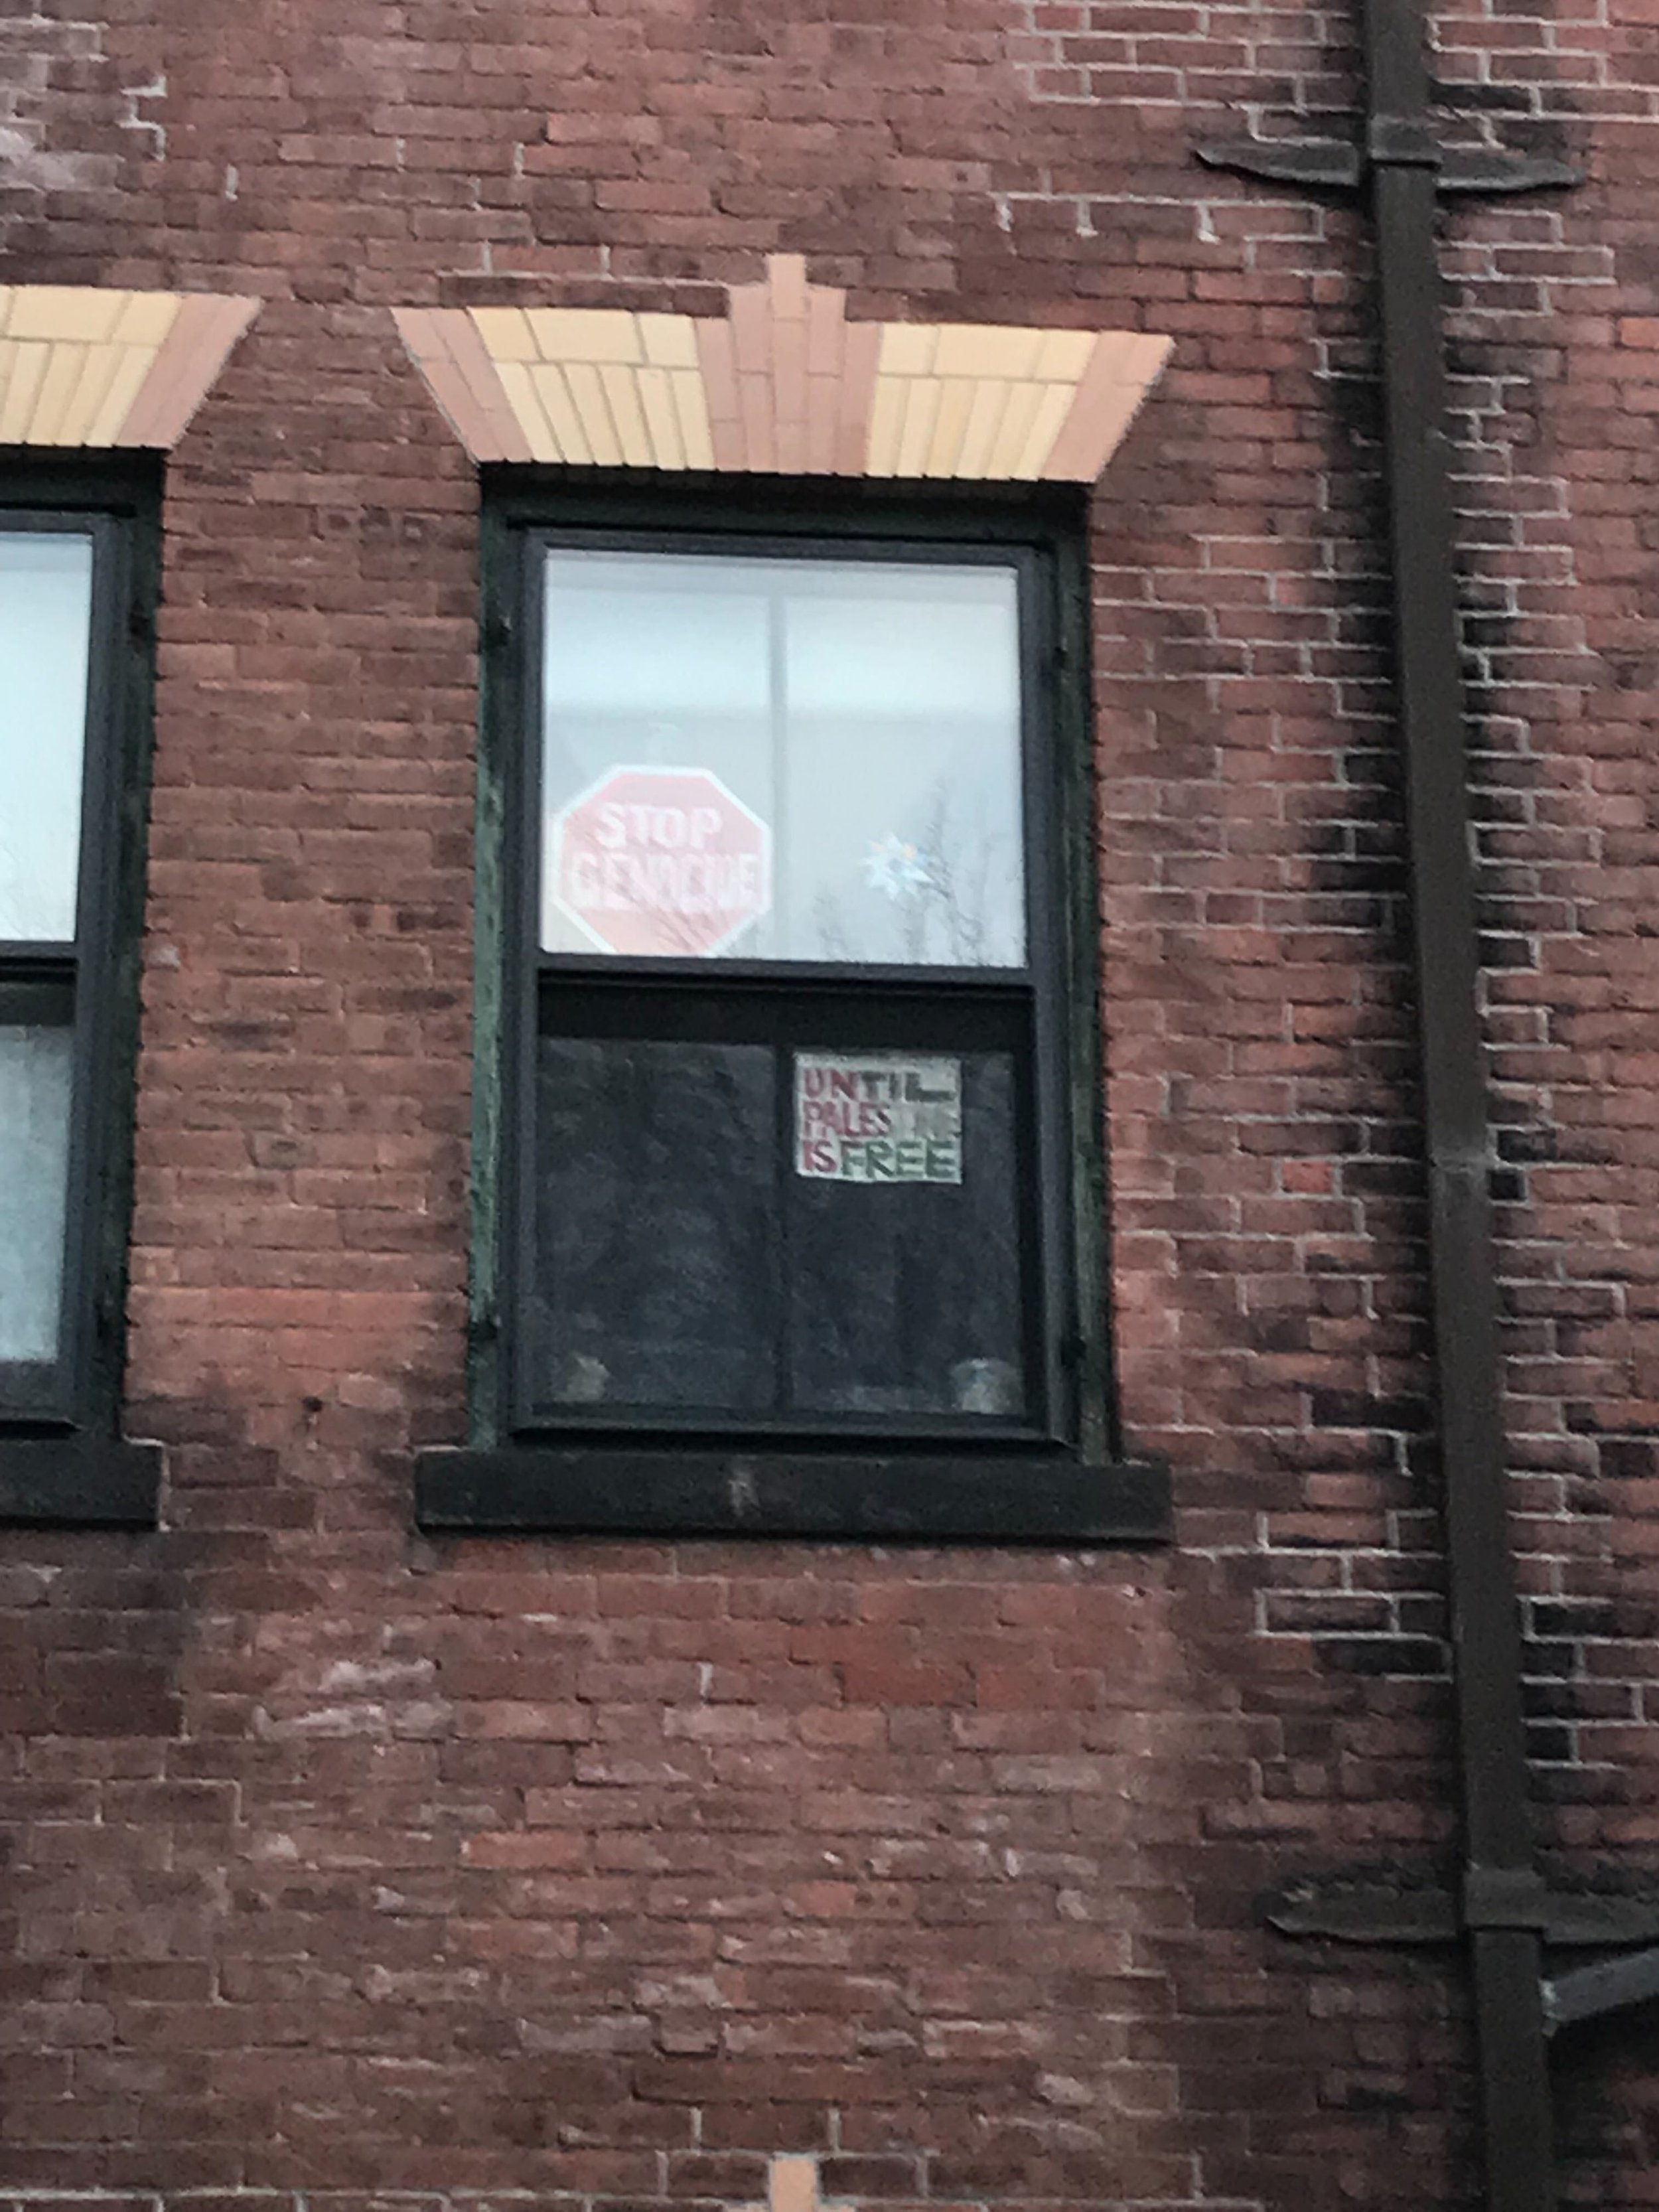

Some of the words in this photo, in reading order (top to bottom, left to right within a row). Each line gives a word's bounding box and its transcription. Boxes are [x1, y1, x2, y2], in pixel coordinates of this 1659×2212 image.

[596, 802, 723, 848] STOP
[804, 1069, 958, 1102] UNTIL
[804, 1102, 960, 1139] PALES
[803, 1140, 837, 1172] IS
[840, 1140, 956, 1178] FREE
